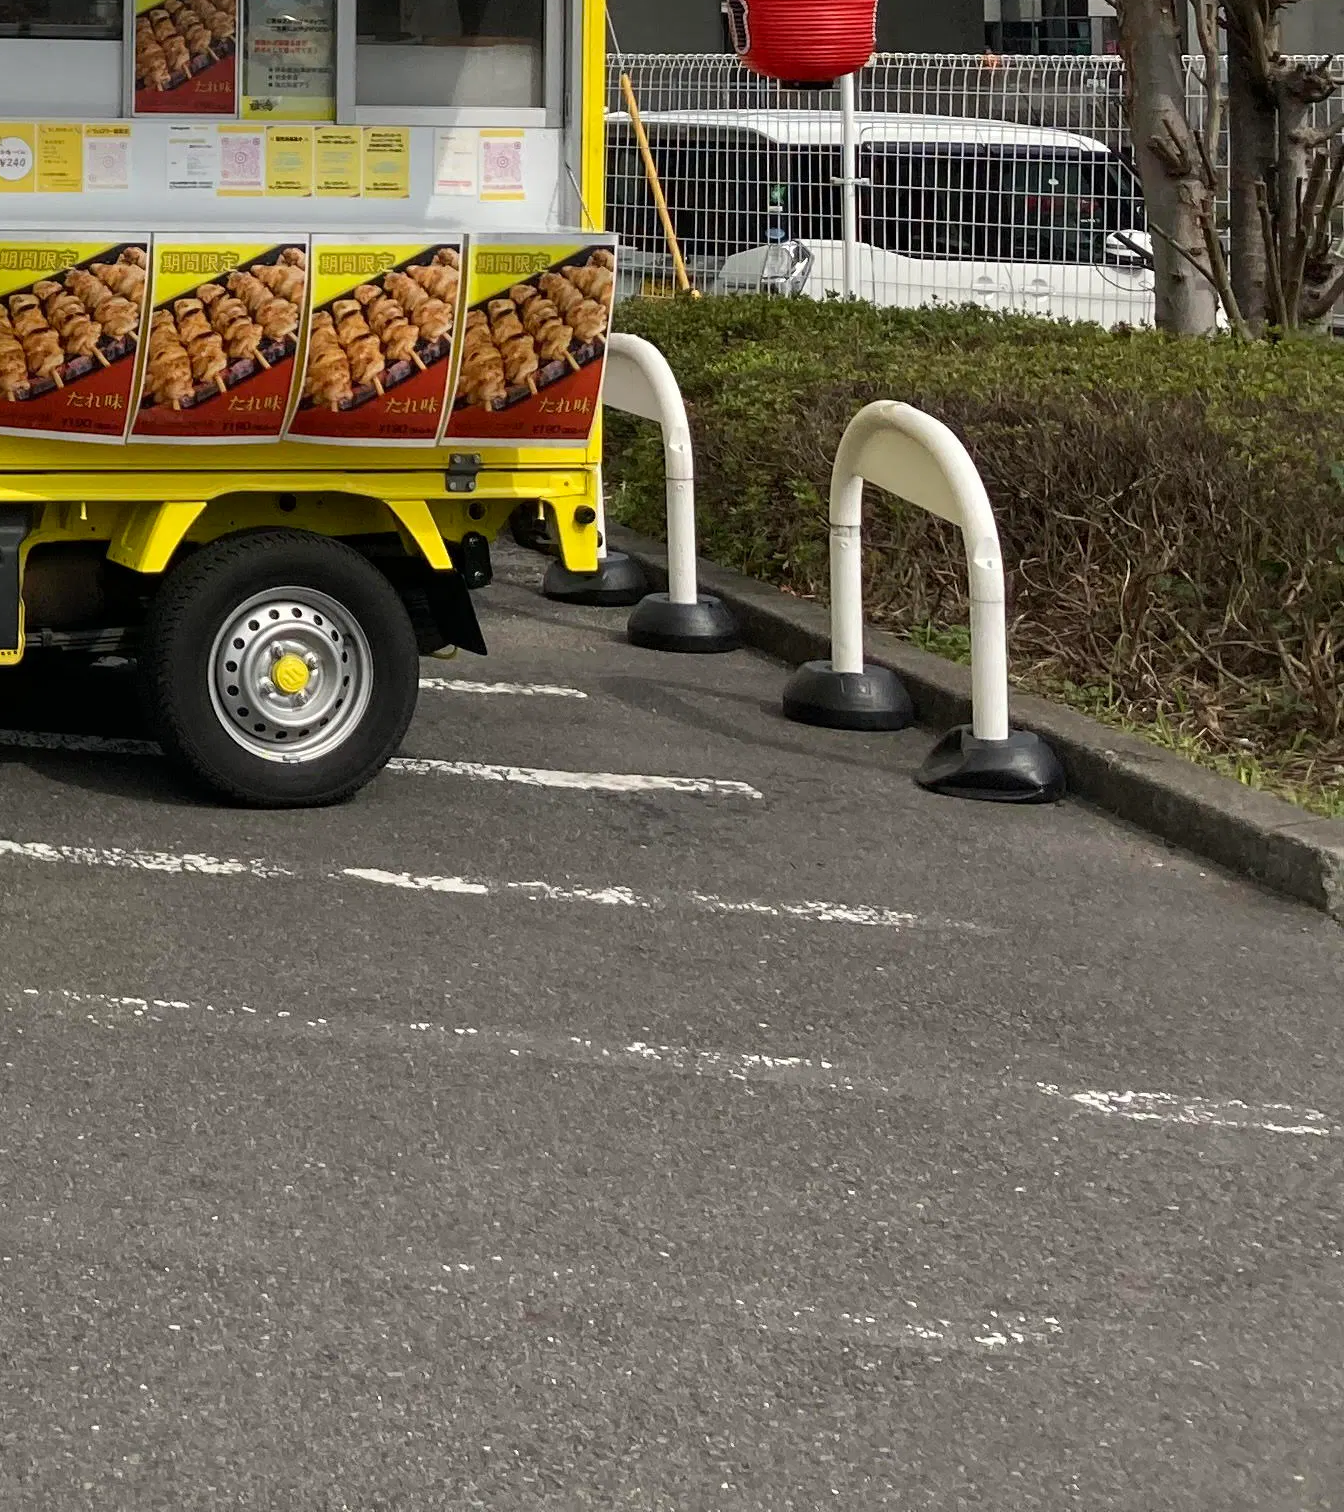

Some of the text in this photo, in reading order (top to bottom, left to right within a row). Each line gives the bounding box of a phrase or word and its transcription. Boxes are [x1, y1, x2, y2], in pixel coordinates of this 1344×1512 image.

[0, 158, 26, 168] ¥240
[162, 252, 240, 272] 期間限定
[319, 253, 396, 274] 期間限定
[476, 253, 552, 273] 期間限定
[67, 391, 124, 409] たれ味
[229, 395, 282, 411] たれ味
[385, 396, 438, 414] たれ味
[539, 396, 591, 414] たれ味
